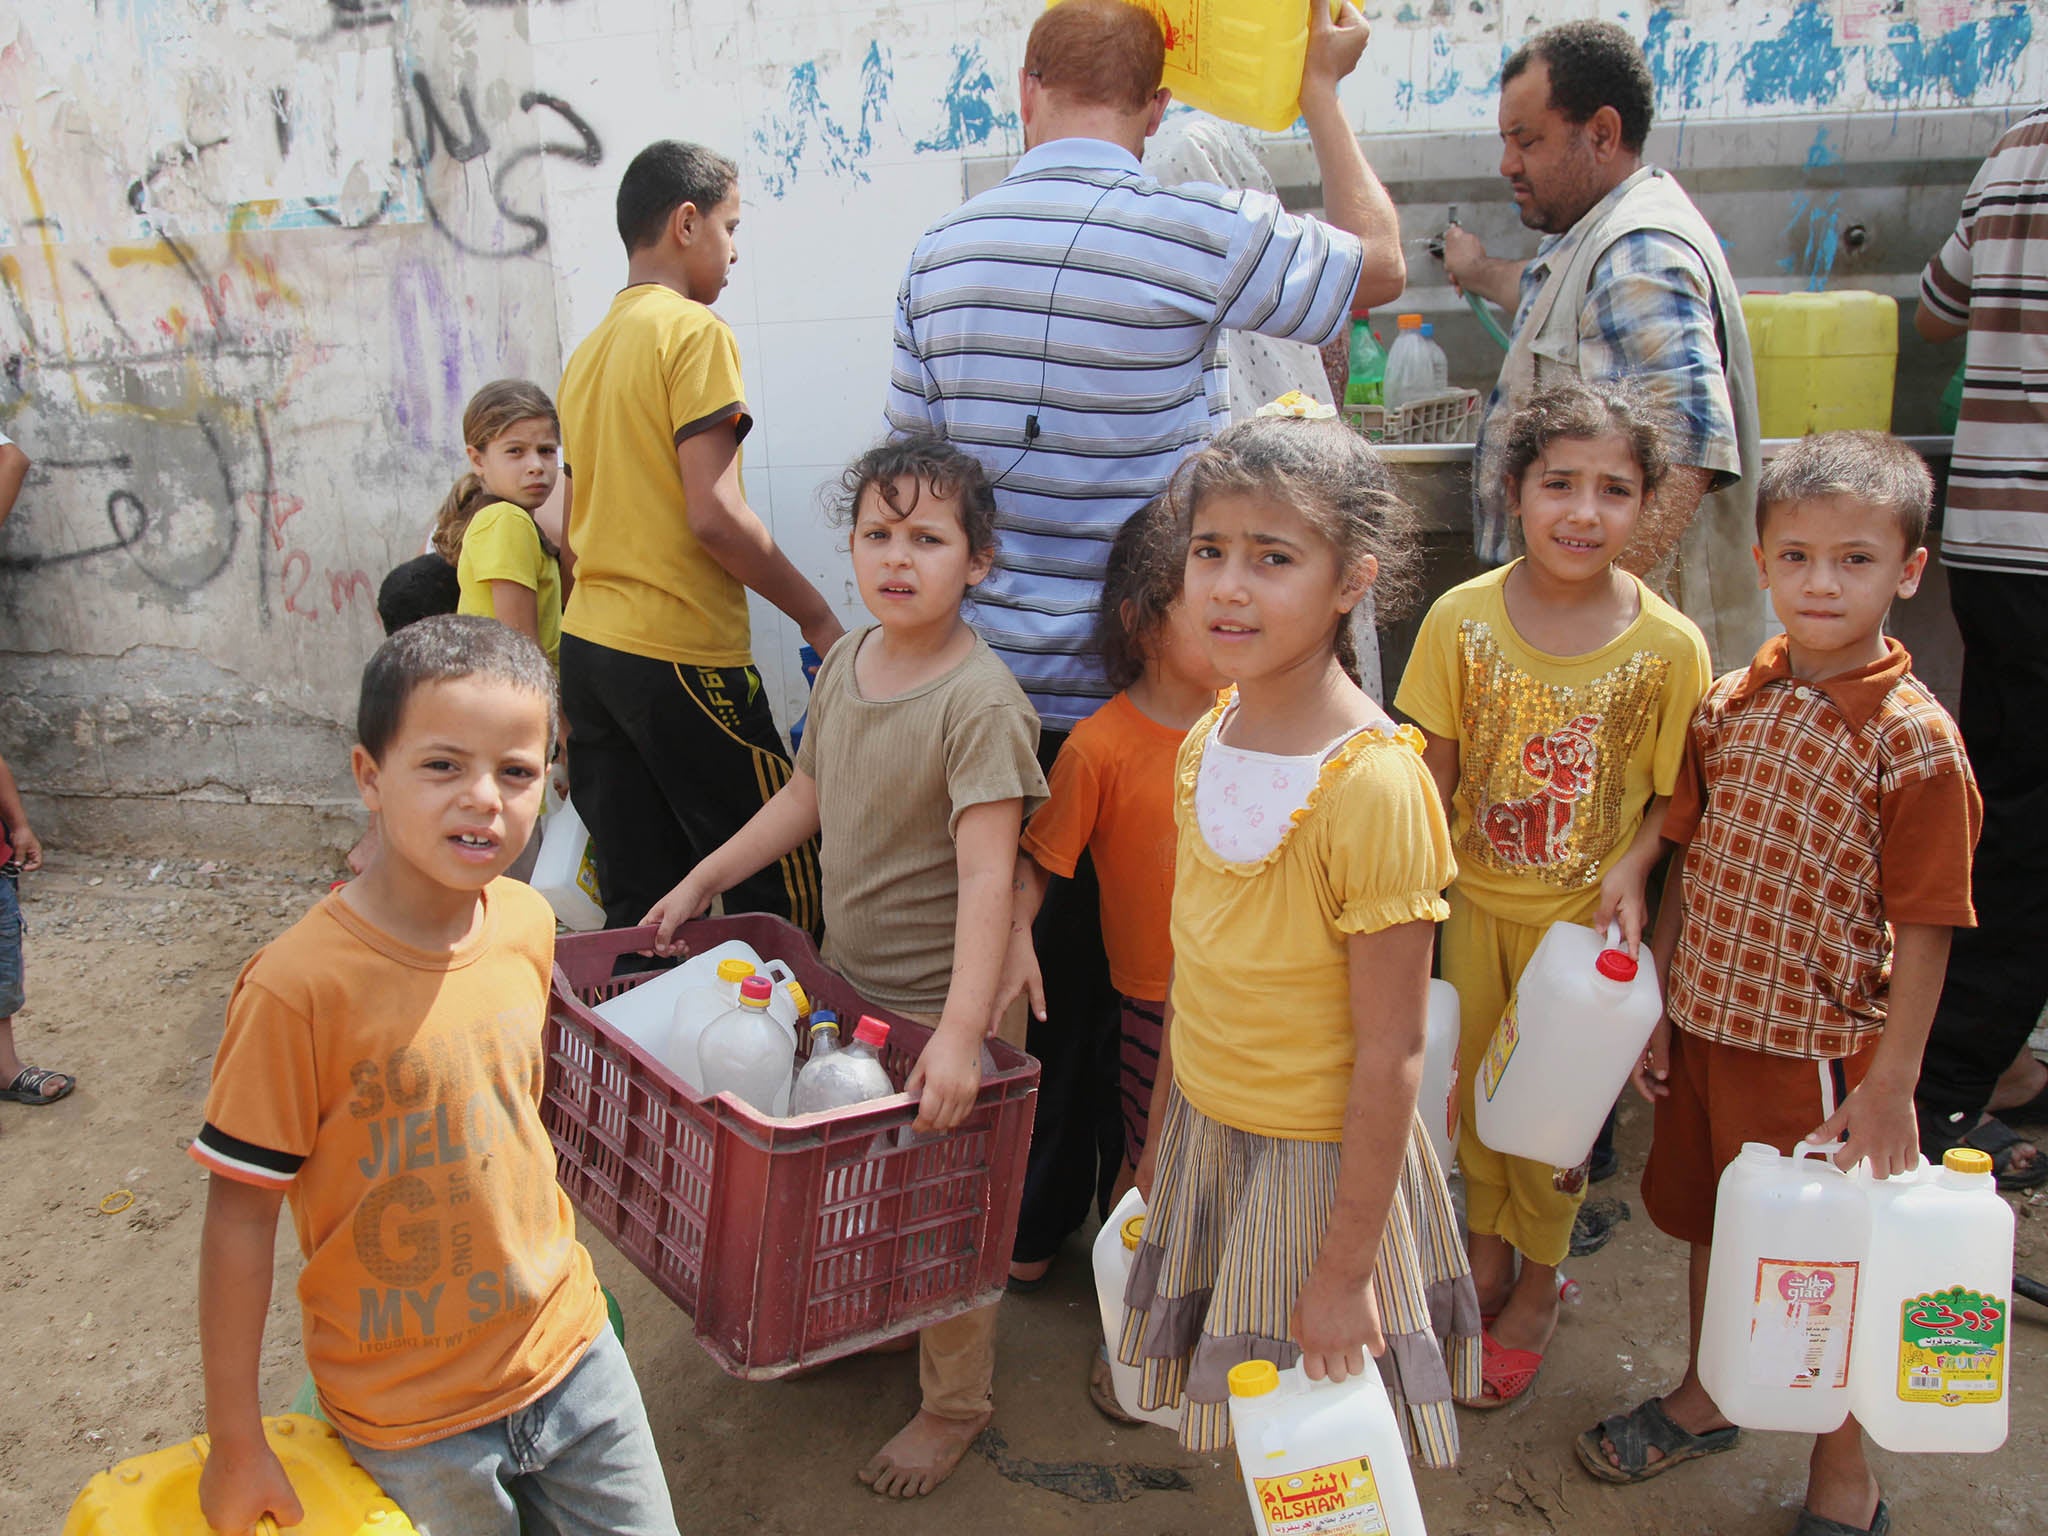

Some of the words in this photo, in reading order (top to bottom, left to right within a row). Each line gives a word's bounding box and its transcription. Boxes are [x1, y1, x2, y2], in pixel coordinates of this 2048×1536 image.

[451, 1220, 474, 1278] LONG
[1788, 1287, 1826, 1304] glatt
[358, 1282, 446, 1342] MY
[1909, 1300, 2001, 1336] فروتي
[1921, 1365, 1929, 1375] 4
[1937, 1355, 1993, 1369] FRUITY
[1263, 1472, 1349, 1511] الشام
[1271, 1493, 1346, 1521] ALSHAM
